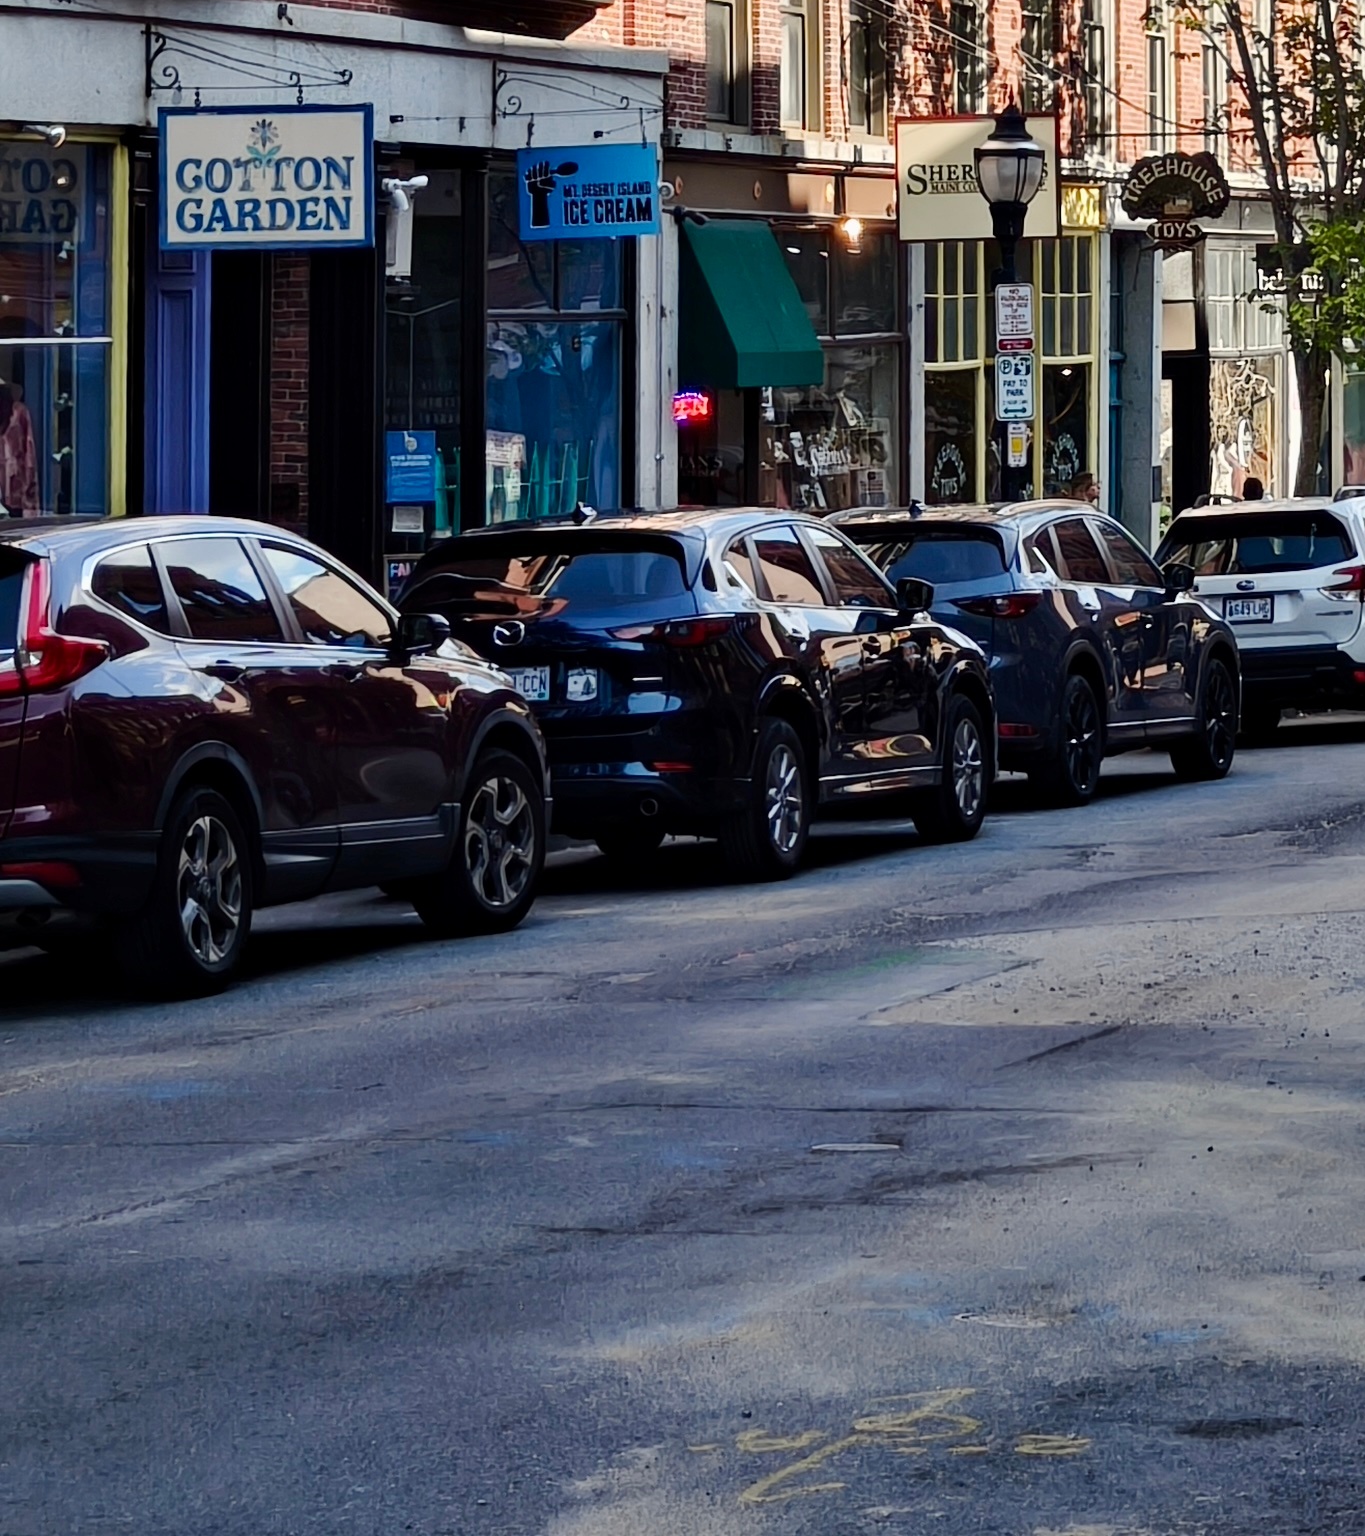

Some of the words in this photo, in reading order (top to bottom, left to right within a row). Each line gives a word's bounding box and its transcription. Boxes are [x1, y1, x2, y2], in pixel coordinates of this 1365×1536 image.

[563, 184, 580, 198] MT.
[582, 183, 614, 198] DESERT
[617, 181, 652, 196] ISLAND
[931, 182, 960, 193] MAINE
[1122, 158, 1225, 204] TREEHOUSE
[175, 196, 354, 233] GARDEN
[563, 199, 590, 226] ICE
[594, 196, 653, 224] CREAM
[1152, 222, 1197, 238] TOYS
